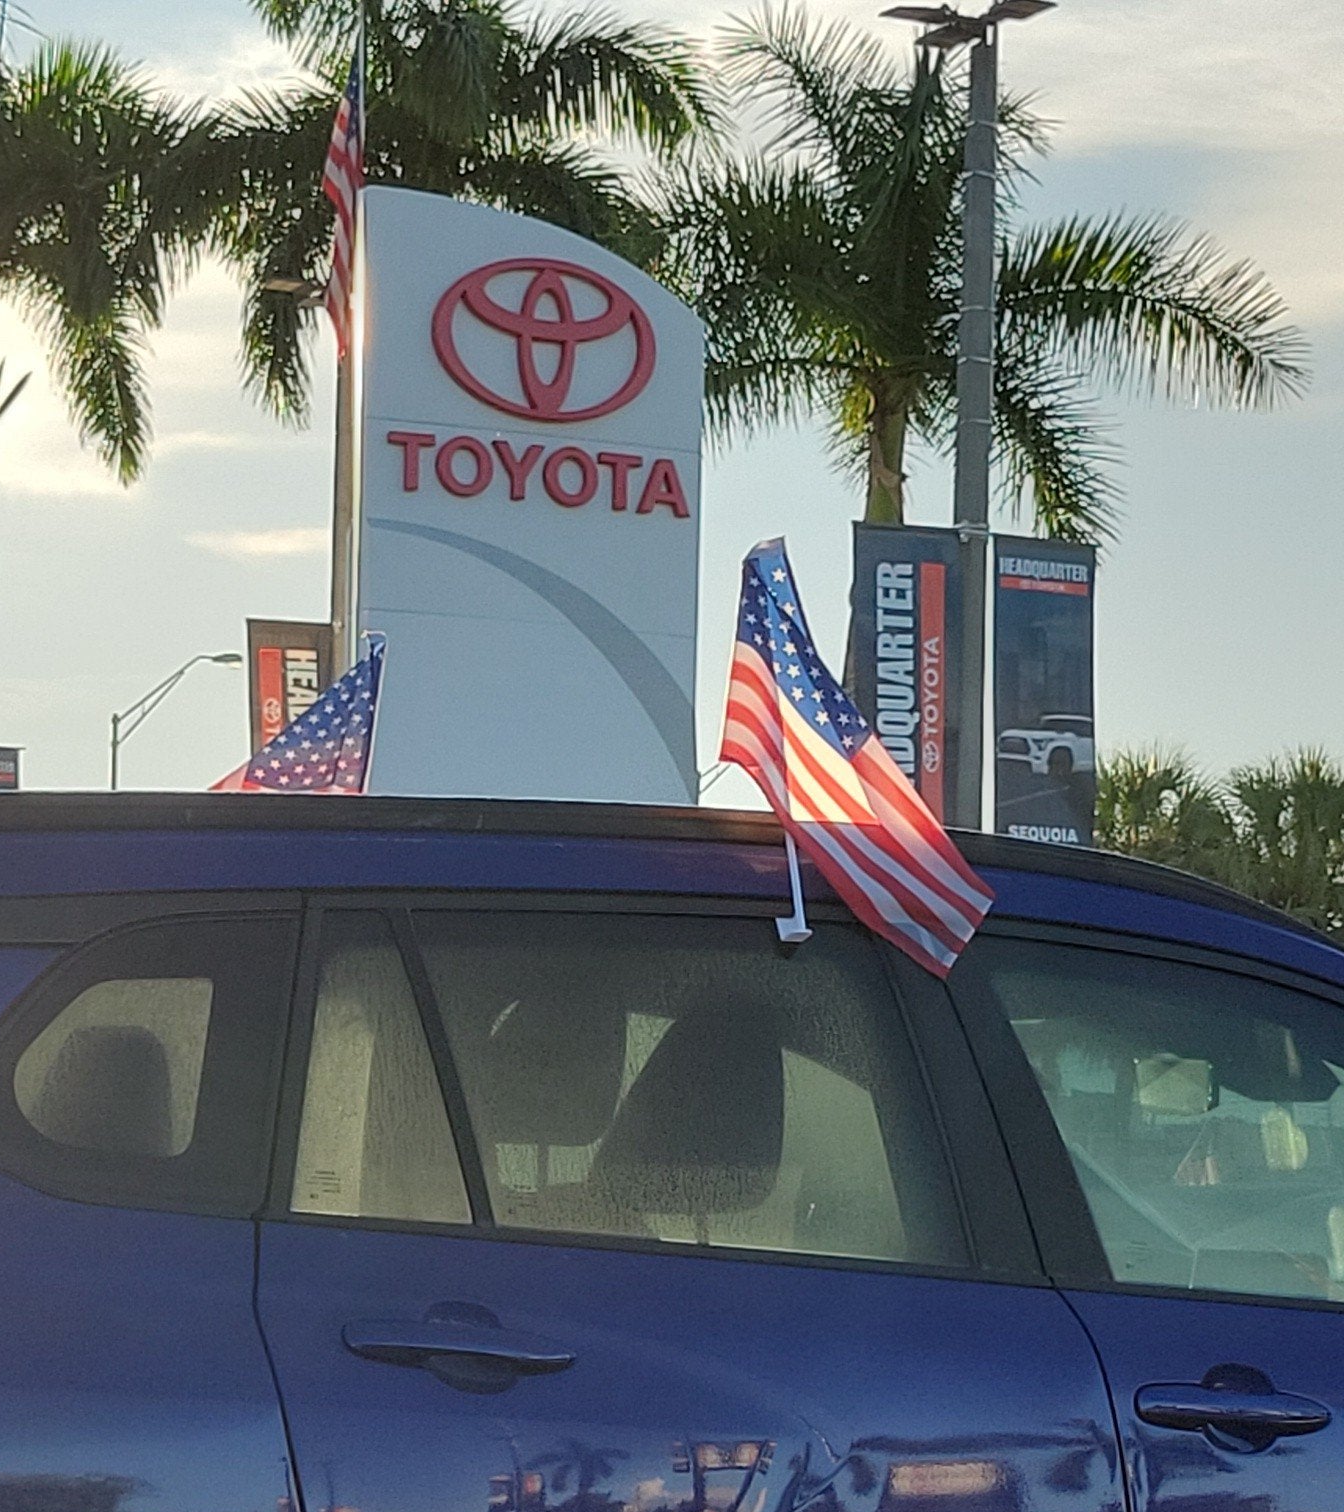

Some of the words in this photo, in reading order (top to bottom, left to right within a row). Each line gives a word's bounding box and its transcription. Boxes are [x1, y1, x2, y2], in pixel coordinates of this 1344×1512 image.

[386, 430, 691, 519] TOYOTA
[999, 557, 1089, 582] HEADQUARTER
[876, 561, 919, 788] DQUARTER
[923, 636, 940, 735] TOYOTA
[1008, 824, 1079, 843] SEQUOIA
